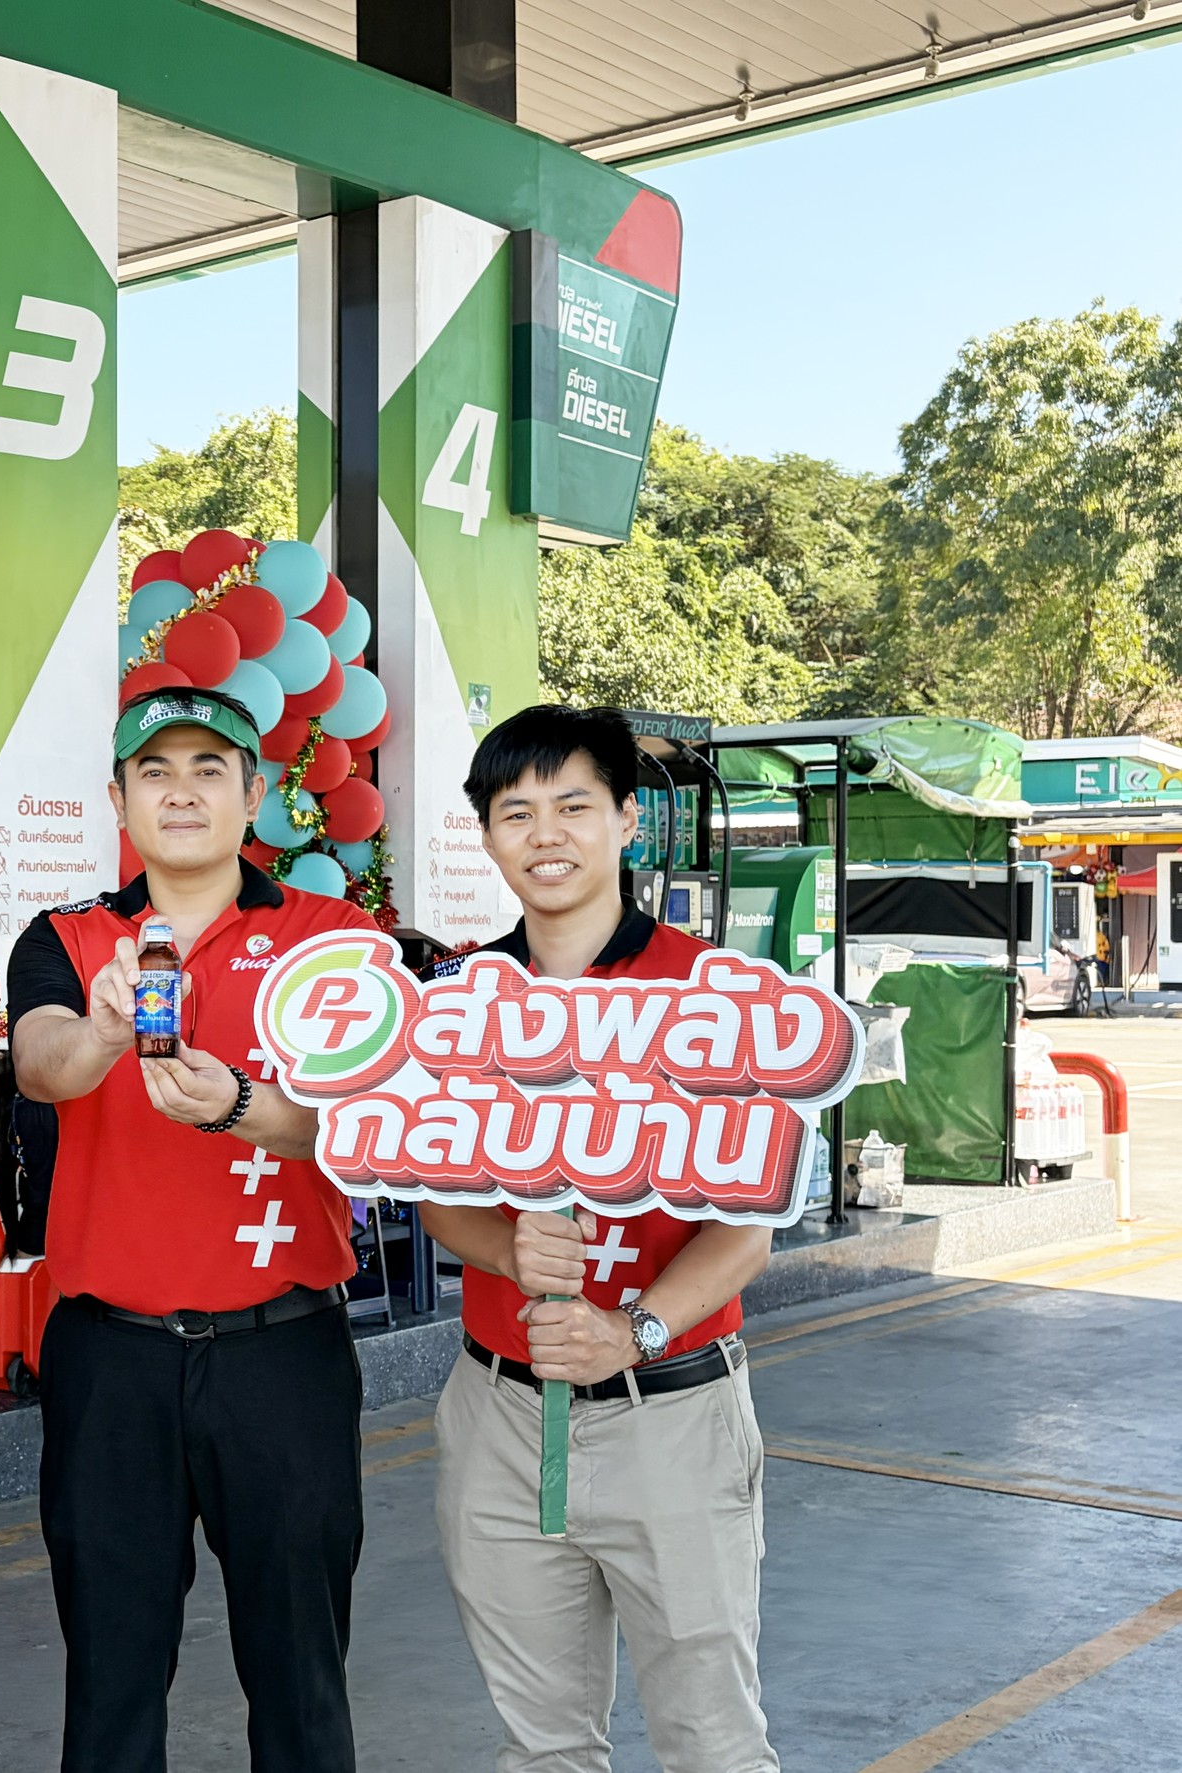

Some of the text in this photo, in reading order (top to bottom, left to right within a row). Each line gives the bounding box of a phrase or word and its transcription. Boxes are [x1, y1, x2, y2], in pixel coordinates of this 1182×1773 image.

[566, 368, 597, 395] ดีเซล
[562, 390, 631, 438] DIESEL
[421, 402, 498, 537] 4
[644, 720, 667, 737] FOR
[18, 794, 83, 818] อันตราย
[18, 828, 83, 844] ดับเครื่องยนต์
[18, 859, 97, 873] ห้ามก่อประกายไฟ
[18, 886, 70, 904] ห้ามสูบบุหรี่
[735, 913, 775, 927] Maxnitron
[299, 977, 372, 1050] PT
[413, 965, 822, 1071] ส่งพลัง
[329, 1071, 771, 1186] กลับบ้าน
